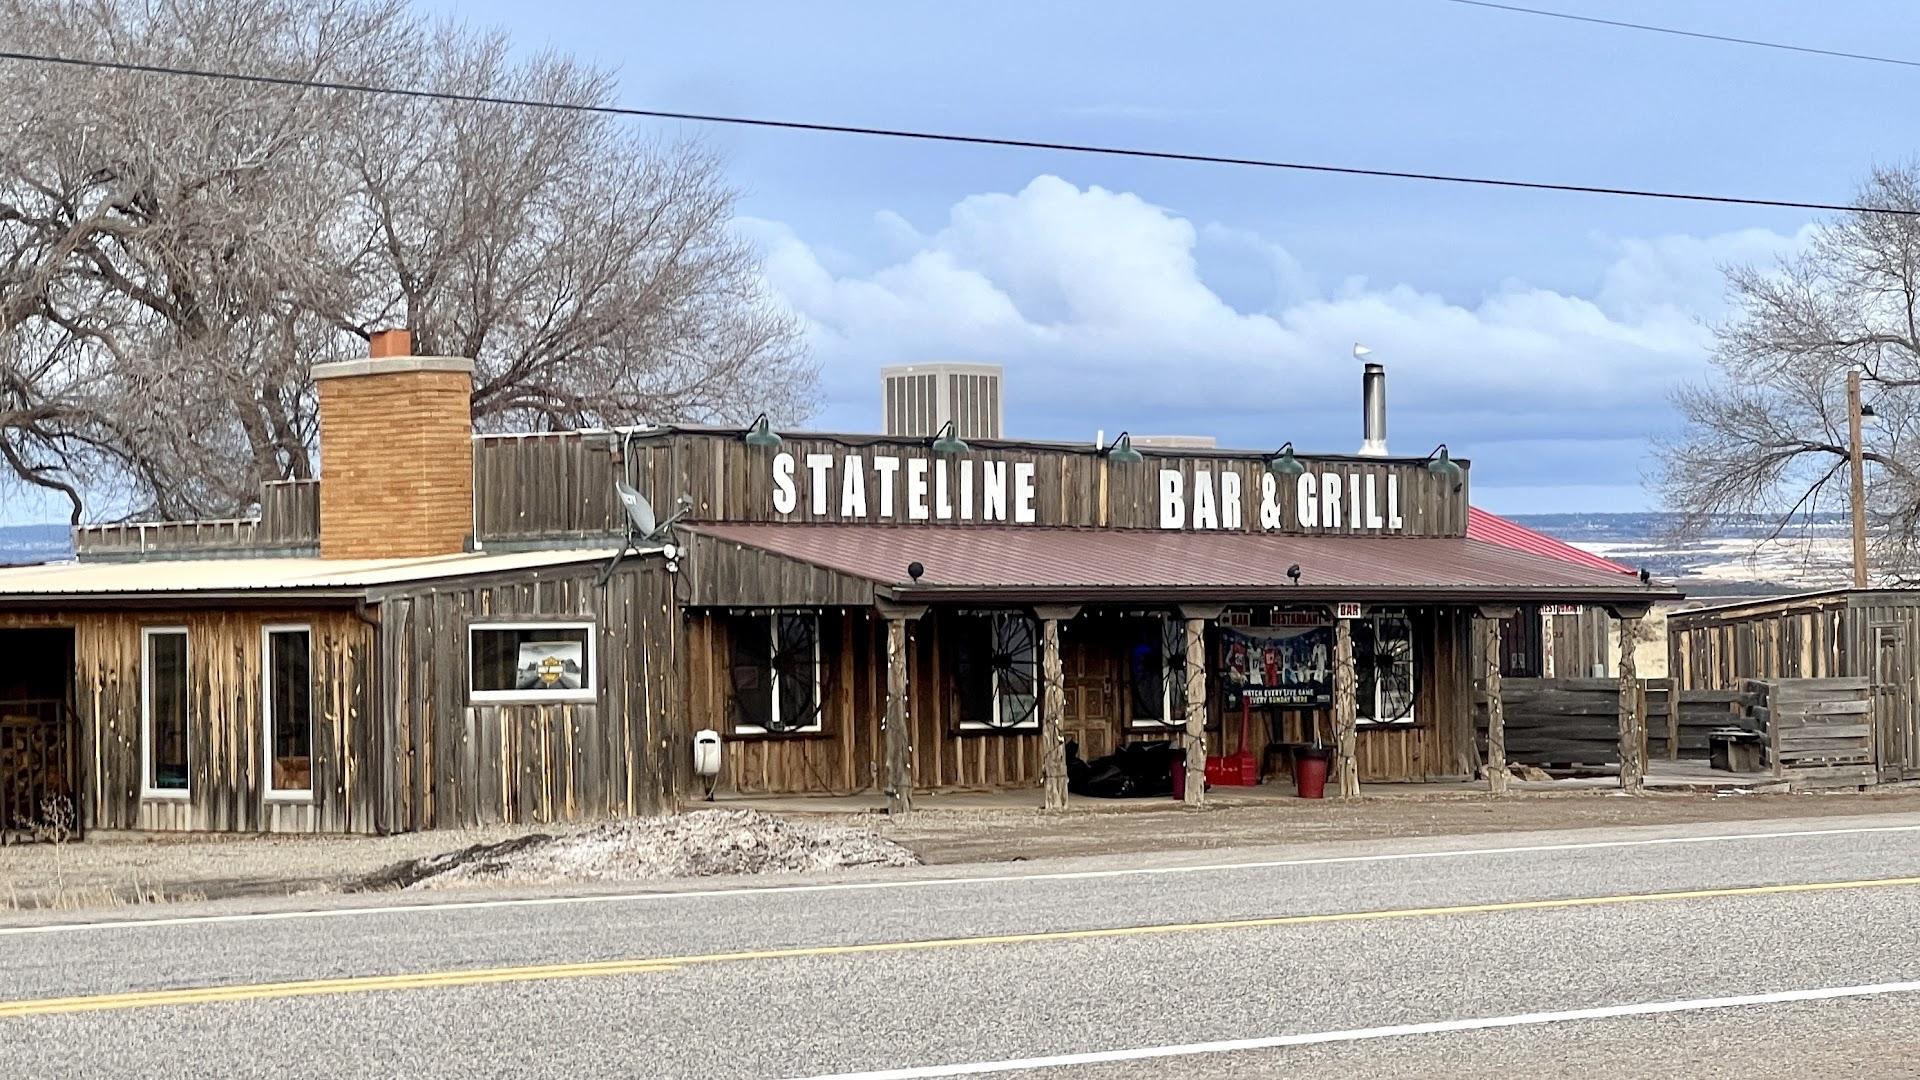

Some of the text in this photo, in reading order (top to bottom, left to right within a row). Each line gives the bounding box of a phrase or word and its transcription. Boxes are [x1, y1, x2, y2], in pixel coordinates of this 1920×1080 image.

[772, 452, 1403, 530] STATELINE BAR & GRILL
[1340, 604, 1359, 616] BAR
[1231, 614, 1248, 625] BAR
[1263, 688, 1283, 697] EVERY
